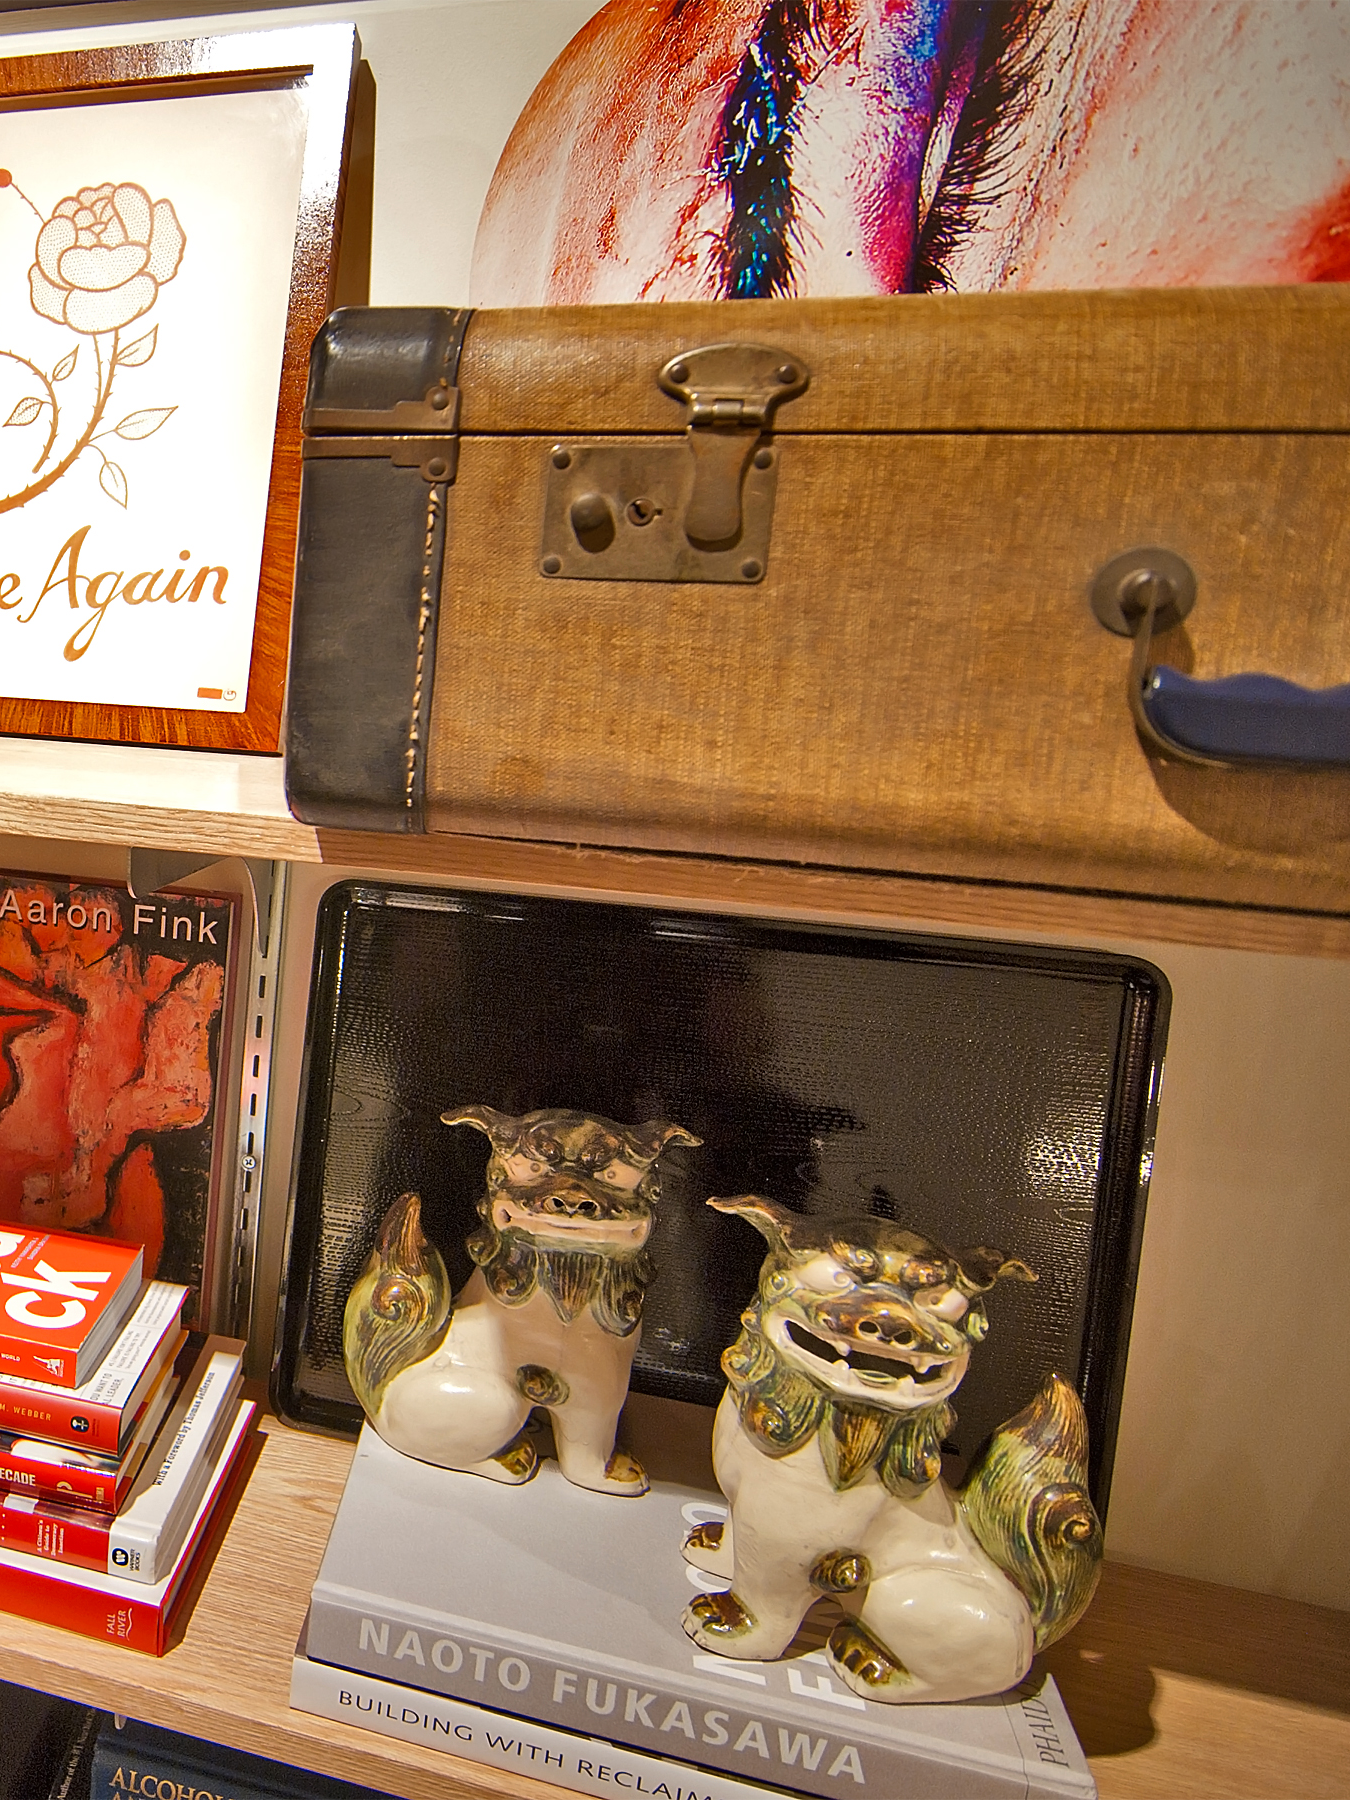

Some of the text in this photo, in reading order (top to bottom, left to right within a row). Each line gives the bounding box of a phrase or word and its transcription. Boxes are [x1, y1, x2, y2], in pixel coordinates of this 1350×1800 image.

[18, 526, 228, 661] Again
[0, 888, 218, 945] Aaron Fink
[0, 1259, 112, 1330] ck
[0, 1352, 21, 1362] WORLD
[196, 1371, 216, 1401] Jefferson
[0, 1403, 10, 1413] M.
[13, 1406, 52, 1422] WEBBER
[183, 1399, 202, 1425] Thomas
[179, 1421, 192, 1434] by
[164, 1434, 185, 1464] Foreword
[153, 1468, 168, 1486] With
[106, 1613, 116, 1635] FALL
[117, 1609, 127, 1638] RIVER
[359, 1617, 866, 1785] NAOTO FUKASAWA
[338, 1690, 473, 1741] BUILDING
[486, 1731, 564, 1768] WITH
